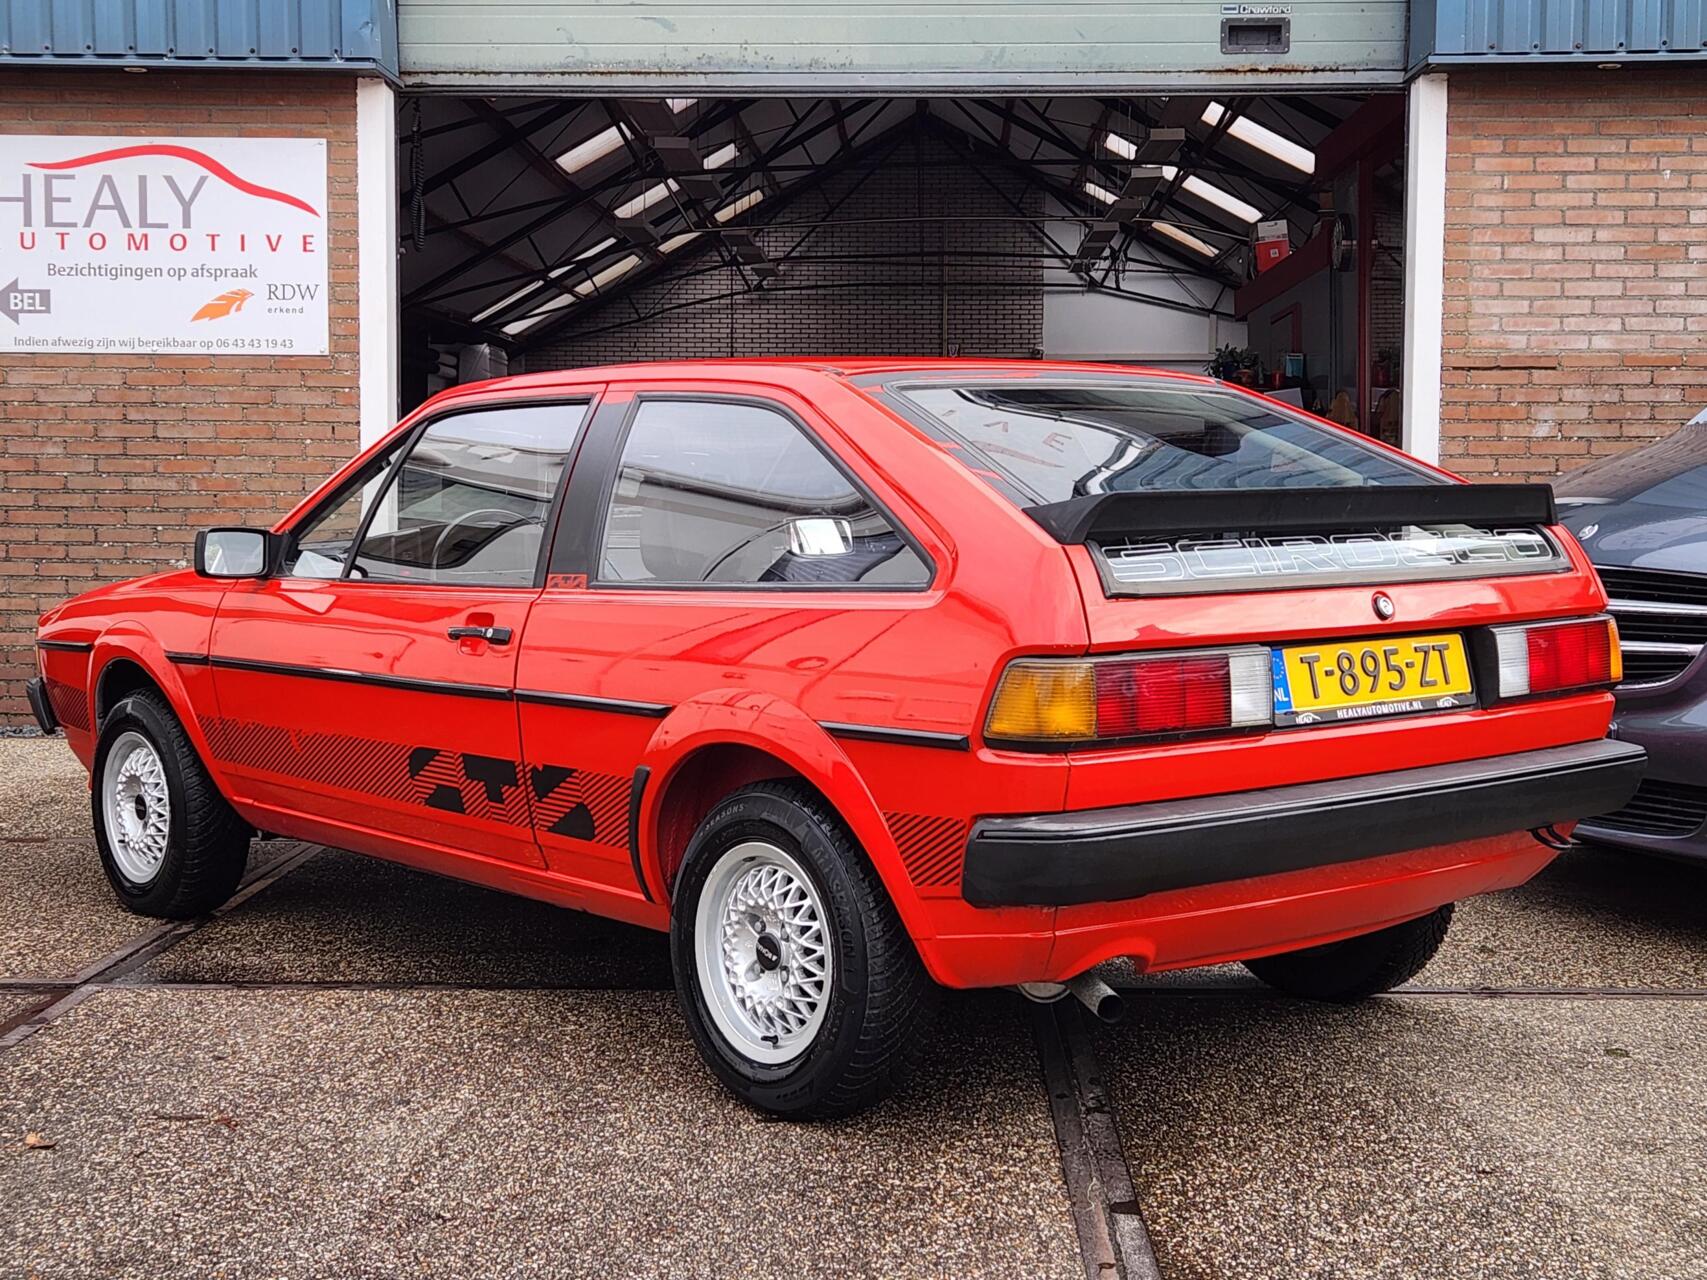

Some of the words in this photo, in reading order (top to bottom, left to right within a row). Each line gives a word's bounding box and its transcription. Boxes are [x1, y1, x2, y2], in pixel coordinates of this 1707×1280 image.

[1240, 4, 1291, 14] Crawford
[0, 173, 209, 229] HEALY
[19, 232, 316, 253] UTOMOTIVE
[47, 263, 163, 281] Bezichtigingen
[167, 265, 187, 281] op
[190, 264, 258, 280] afspraak
[266, 283, 320, 301] RDW
[9, 292, 46, 311] BEL
[267, 306, 304, 314] erkend
[14, 336, 49, 347] Indien
[51, 336, 94, 349] afwezig
[96, 337, 116, 349] zijn
[118, 337, 136, 349] wij
[137, 337, 197, 348] bereikbaar
[199, 340, 214, 350] op
[216, 338, 230, 348] 06
[231, 339, 246, 348] 43
[247, 339, 262, 348] 43
[265, 339, 278, 348] 19
[279, 339, 294, 348] 43
[1101, 528, 1554, 583] SCIROCCO
[1300, 644, 1450, 699] T-895-ZT
[1273, 687, 1289, 702] NL
[1337, 702, 1423, 718] HEALYAUTOMOTIVE.NL
[1296, 715, 1312, 724] HEALY
